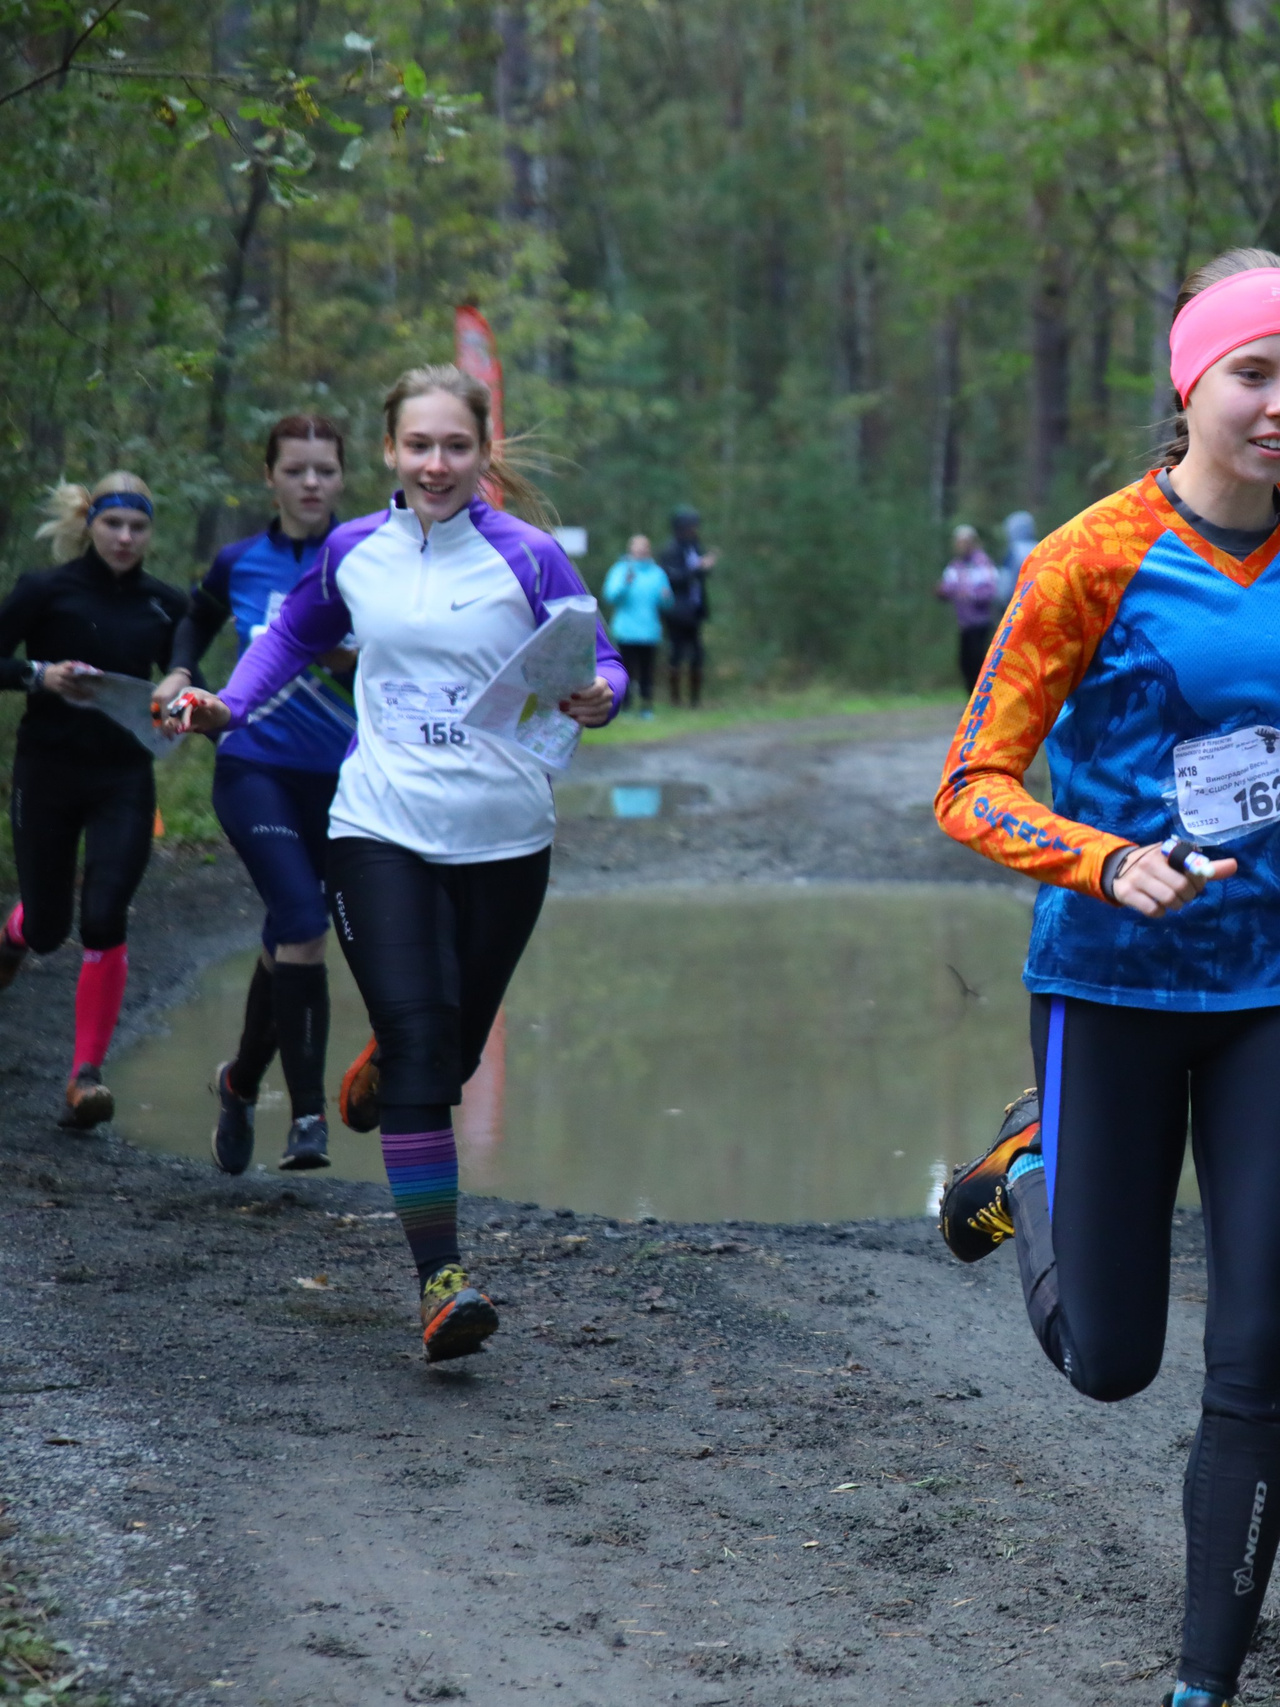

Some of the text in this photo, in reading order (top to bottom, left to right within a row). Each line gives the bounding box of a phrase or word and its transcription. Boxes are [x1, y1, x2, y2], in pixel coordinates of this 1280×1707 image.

[948, 580, 1035, 799] ЧЕЛЯБИНС
[1177, 766, 1198, 778] Ж18
[1244, 1481, 1268, 1567] NORD
